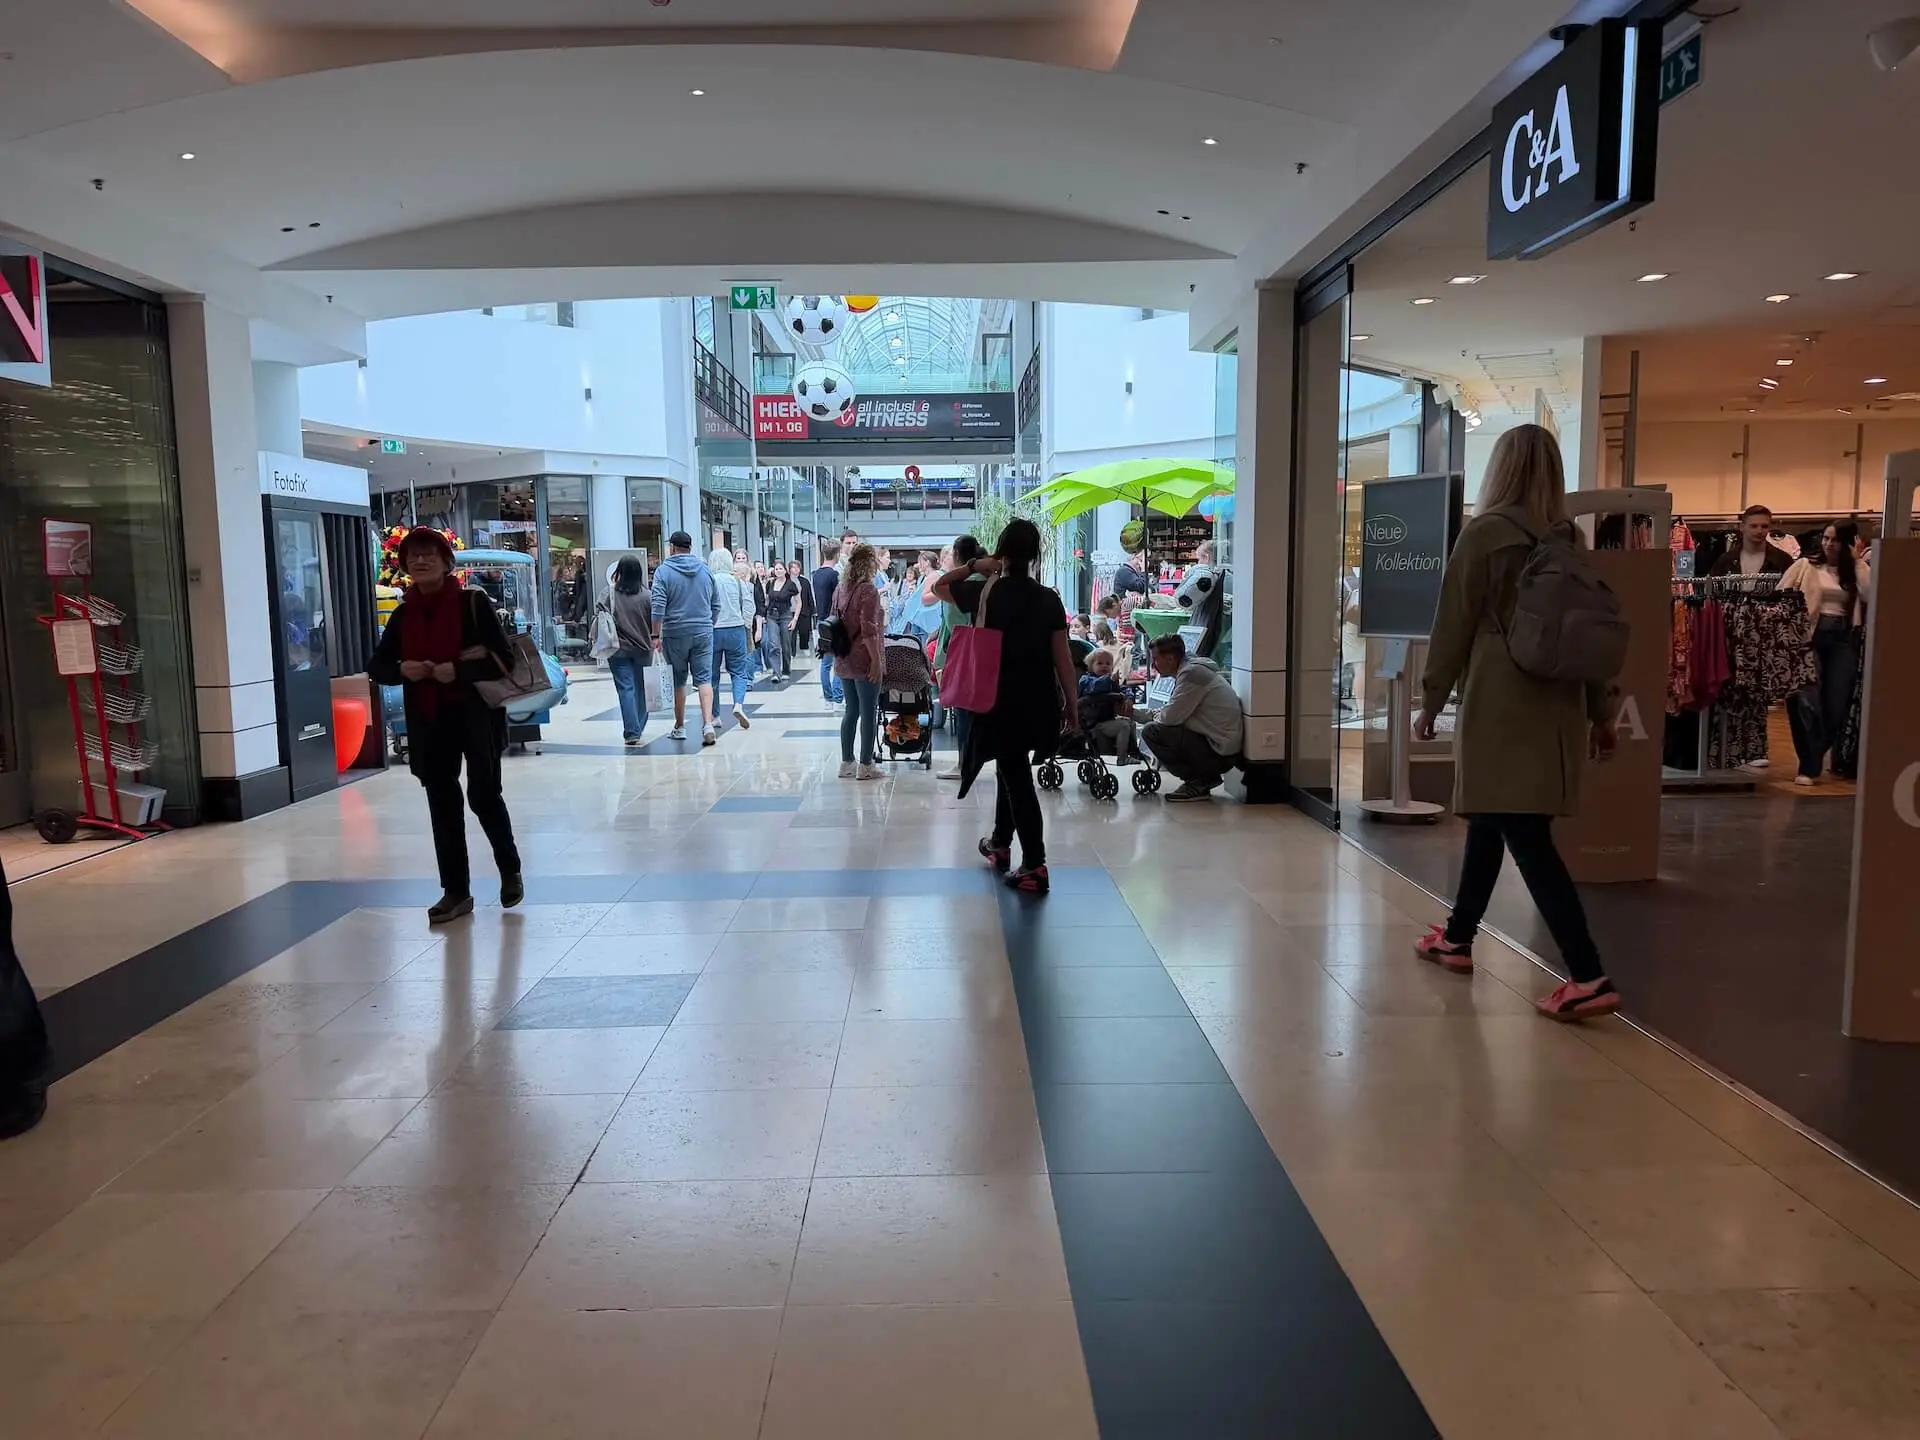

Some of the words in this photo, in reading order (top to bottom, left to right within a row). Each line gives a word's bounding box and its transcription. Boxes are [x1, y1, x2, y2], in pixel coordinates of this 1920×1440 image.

[1501, 84, 1580, 213] C&A
[759, 402, 802, 418] HIER
[858, 400, 873, 412] all
[760, 422, 773, 433] IM
[786, 422, 803, 433] OG
[855, 411, 929, 428] FITNESS
[273, 471, 307, 493] Fotofix
[1365, 523, 1402, 541] Neue
[1375, 551, 1441, 571] Kollektion
